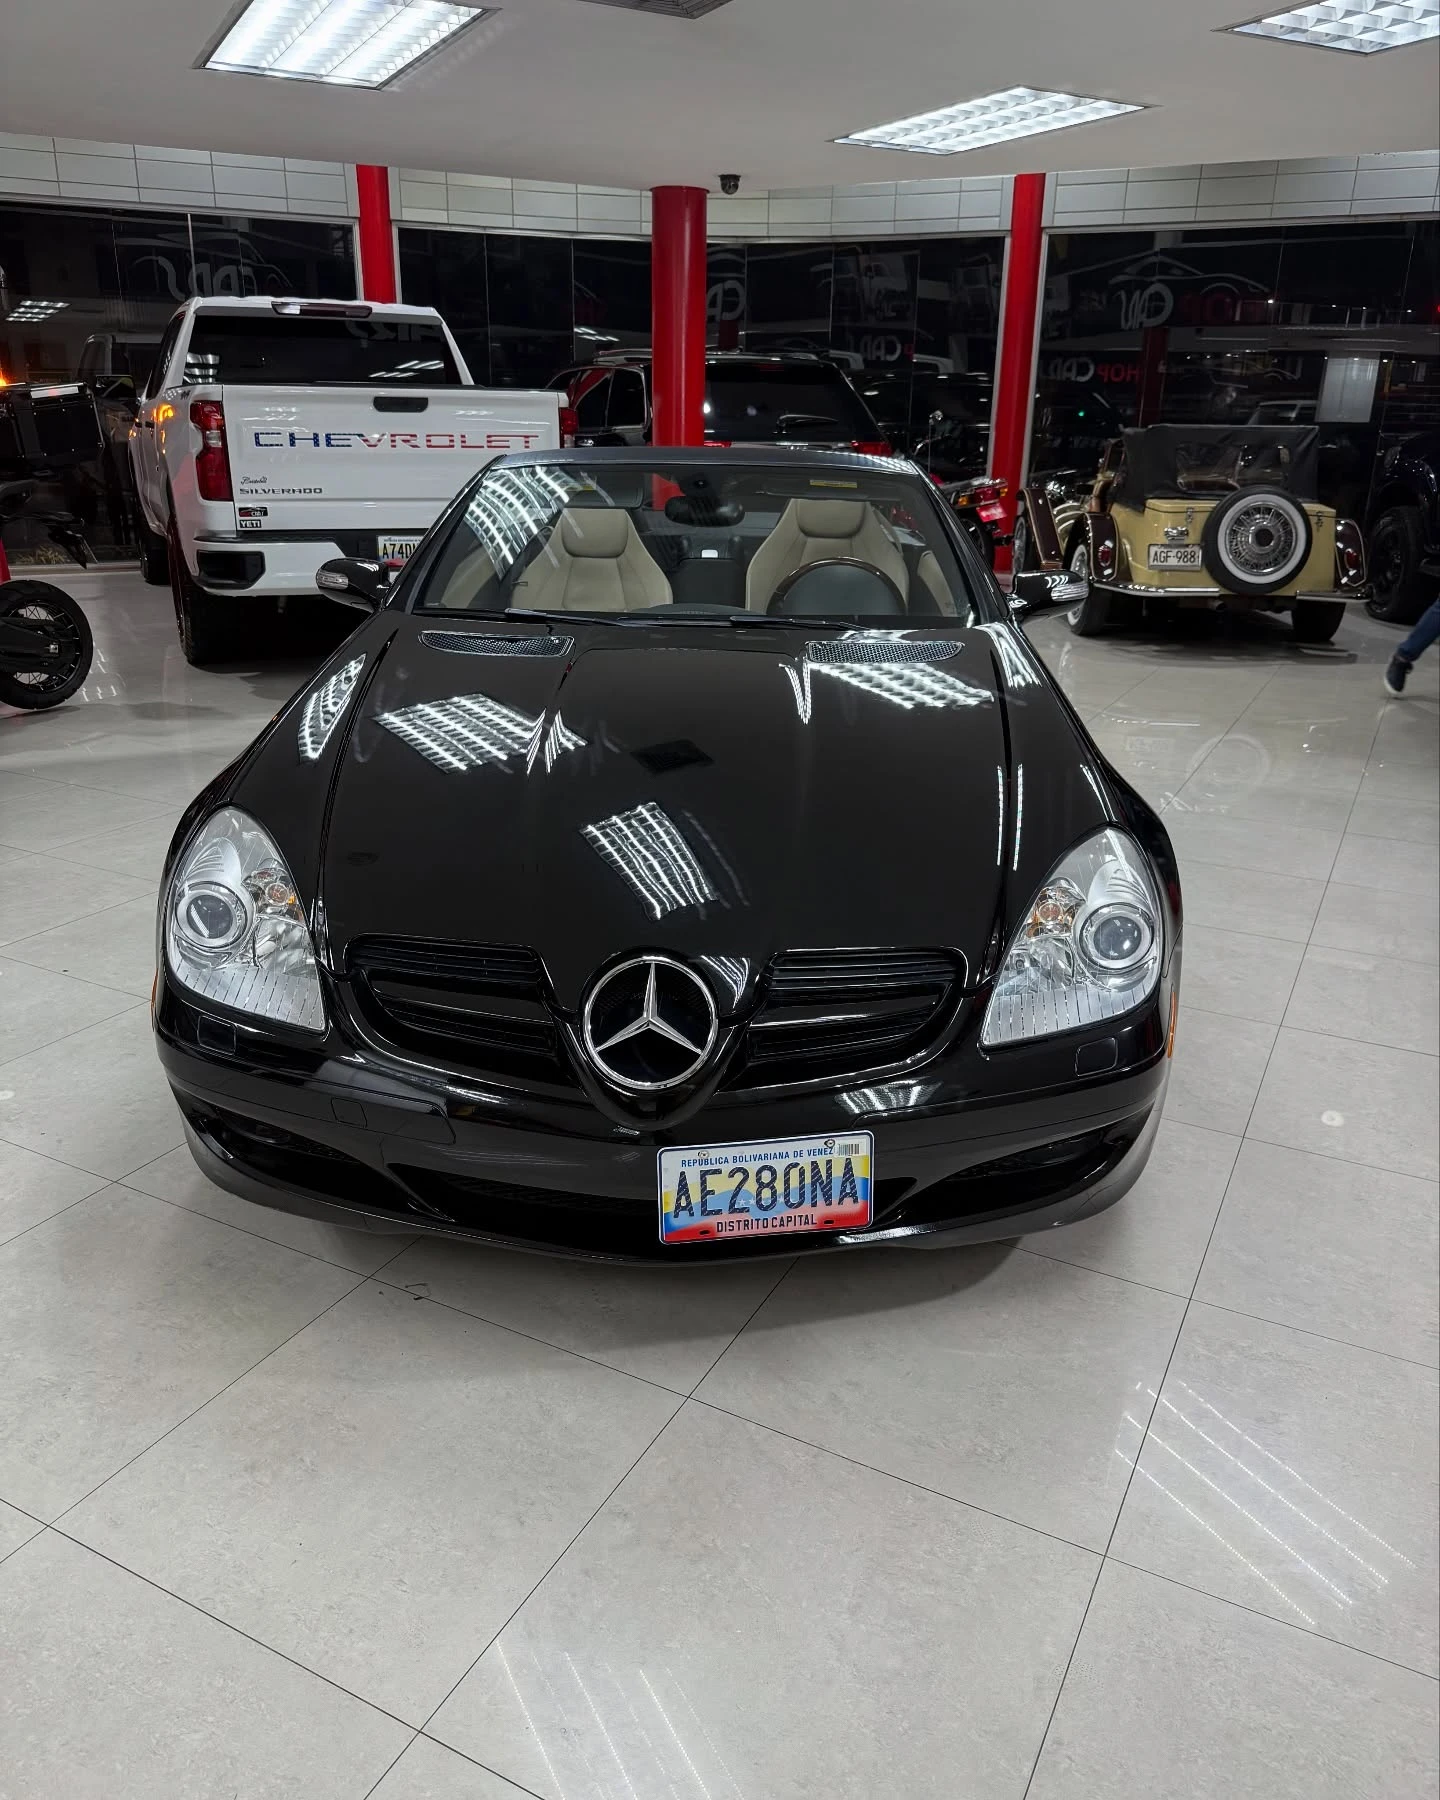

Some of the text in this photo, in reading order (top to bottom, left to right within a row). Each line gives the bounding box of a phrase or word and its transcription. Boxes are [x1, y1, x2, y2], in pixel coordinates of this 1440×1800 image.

[254, 432, 540, 449] CHEVROLET
[239, 487, 323, 495] SILVERADO
[240, 520, 260, 528] YETI
[382, 542, 417, 560] A74D
[1152, 550, 1197, 564] AGF-988
[732, 1151, 790, 1164] BOLIVARIANA
[793, 1149, 804, 1159] DE
[806, 1146, 835, 1158] VENEZ
[672, 1157, 860, 1219] AE280NA
